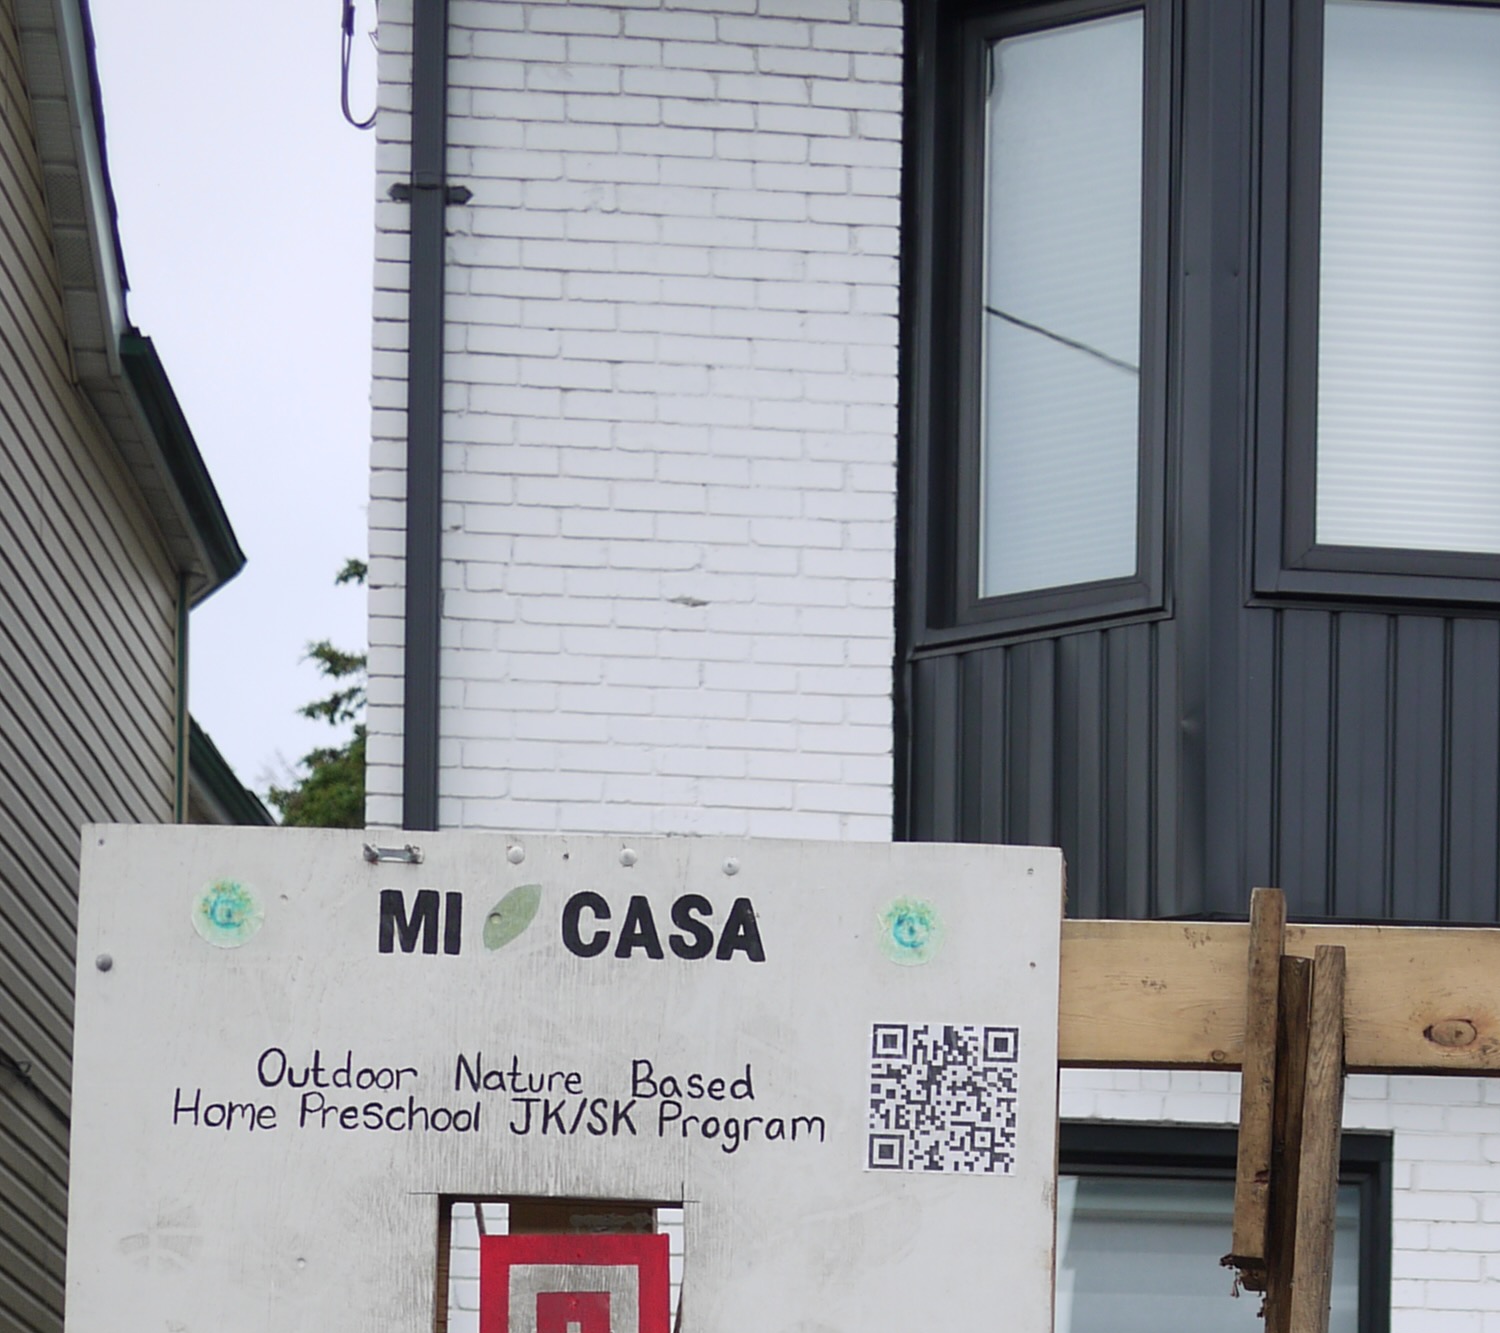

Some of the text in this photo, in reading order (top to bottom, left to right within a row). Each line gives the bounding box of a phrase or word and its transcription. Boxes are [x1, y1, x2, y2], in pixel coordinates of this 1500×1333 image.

[378, 888, 767, 963] MI CASA
[257, 1047, 755, 1101] Outdoor Nature Based
[171, 1088, 826, 1153] Home Preschool JK/SK Program
